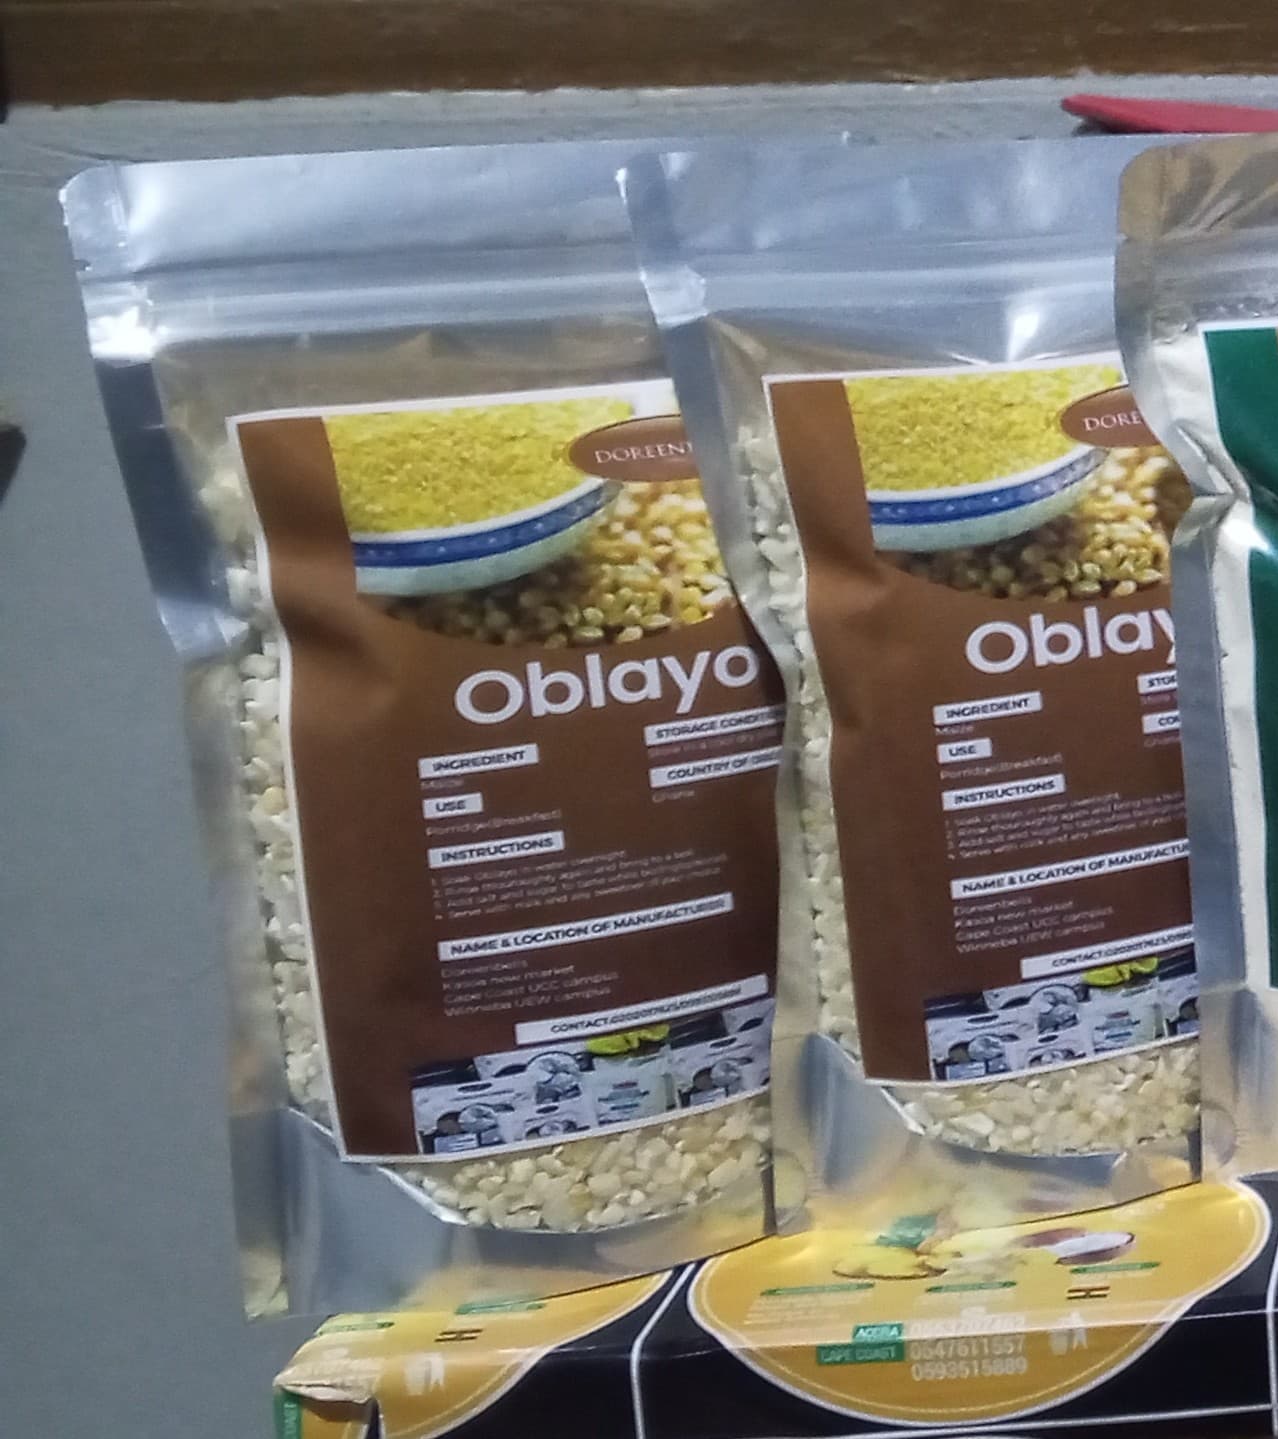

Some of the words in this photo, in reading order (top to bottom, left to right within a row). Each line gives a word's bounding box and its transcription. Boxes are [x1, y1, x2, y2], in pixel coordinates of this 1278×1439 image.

[1083, 413, 1142, 431] DORE
[455, 646, 759, 724] Oblayo
[946, 698, 1030, 718] INGREDIENT
[433, 750, 526, 771] INGREDIENT
[949, 745, 976, 757] USE
[667, 762, 730, 780] COUNTRY
[954, 780, 1055, 804] INSTRUCTIONS
[436, 799, 466, 812] USE
[441, 838, 553, 862] INSTRUCTIONS
[963, 876, 1004, 893] NAME
[1019, 865, 1086, 885] LOCATION
[1089, 859, 1106, 871] OF
[1109, 843, 1189, 868] MANUFACTU
[451, 940, 498, 956] NAME
[514, 926, 588, 946] LOCATION
[591, 921, 612, 934] OF
